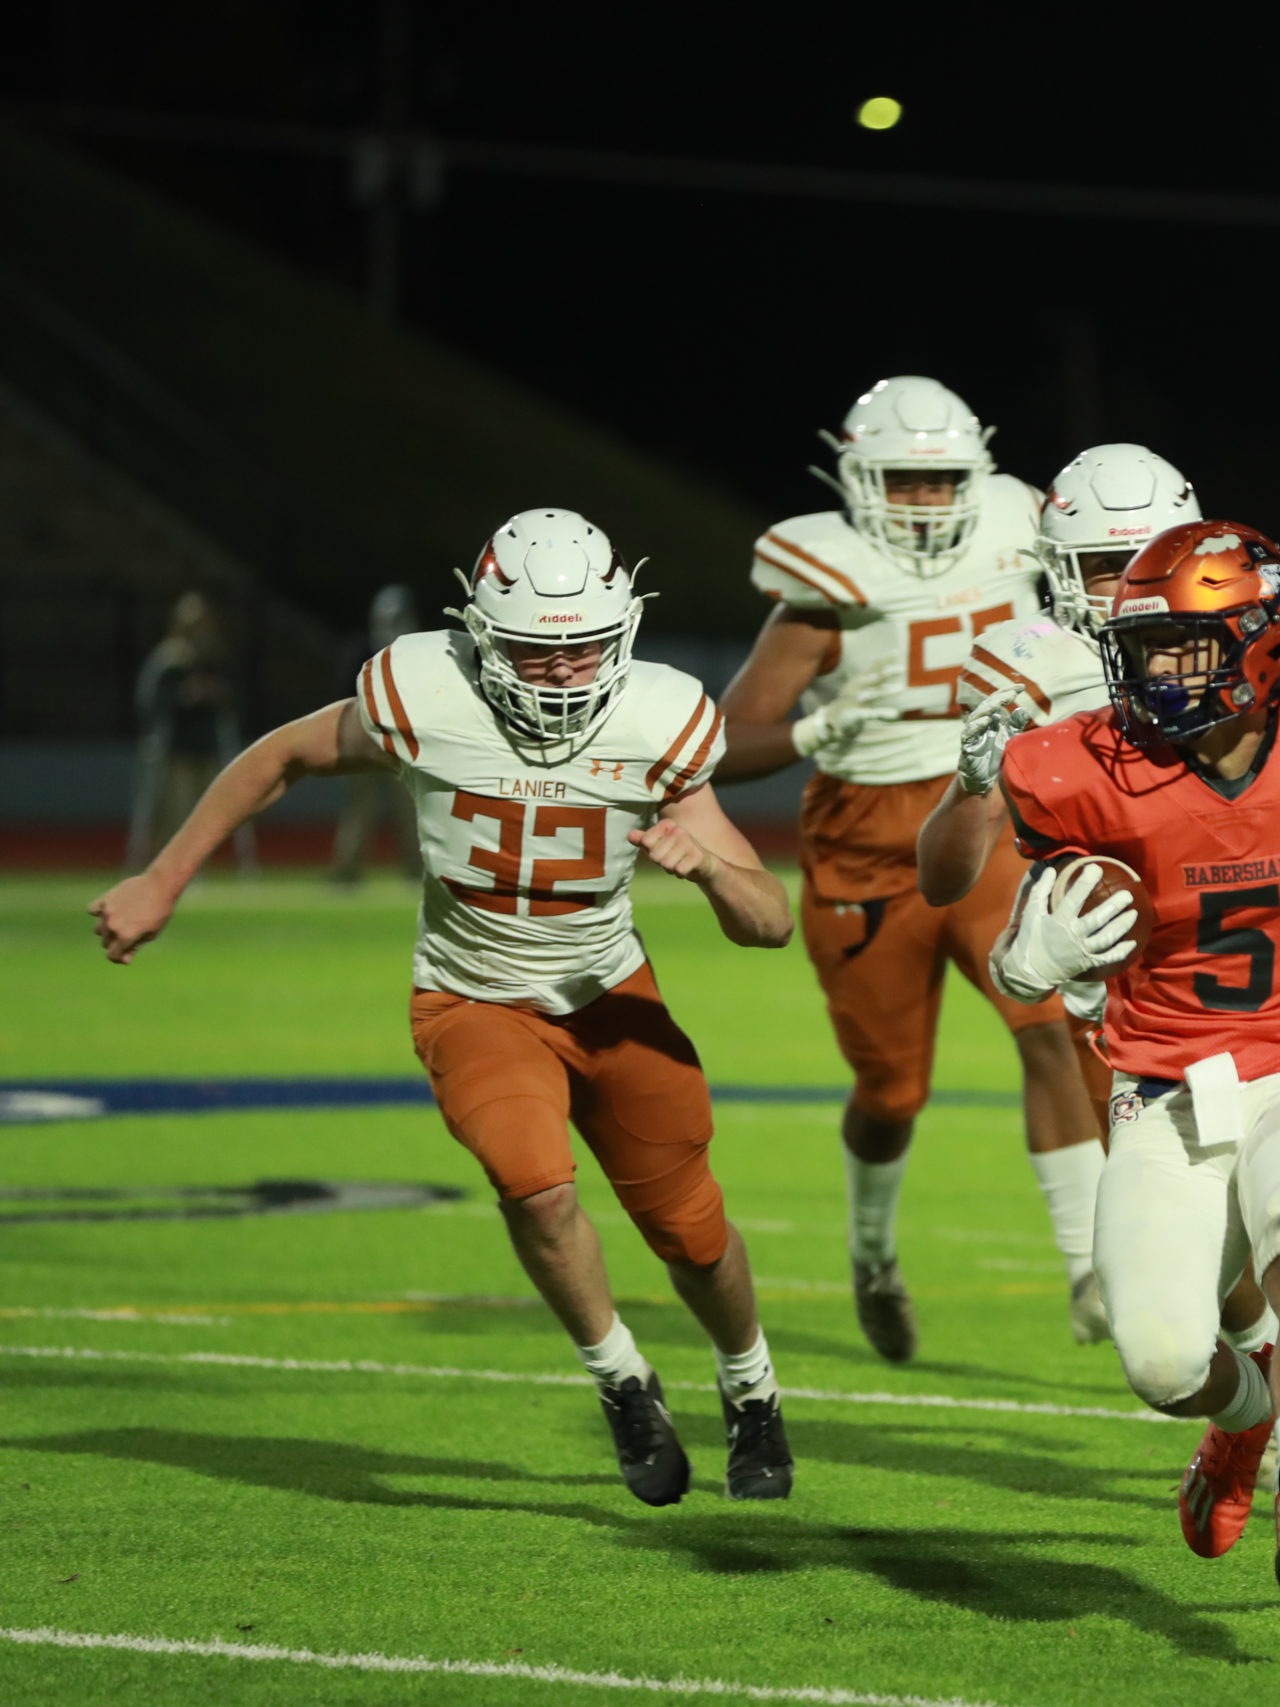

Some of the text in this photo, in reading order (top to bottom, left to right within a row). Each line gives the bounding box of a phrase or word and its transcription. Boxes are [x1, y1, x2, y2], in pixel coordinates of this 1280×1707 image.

[899, 602, 1014, 720] 5
[499, 777, 566, 798] LANIER
[440, 789, 606, 917] 32
[1192, 884, 1280, 1012] 5
